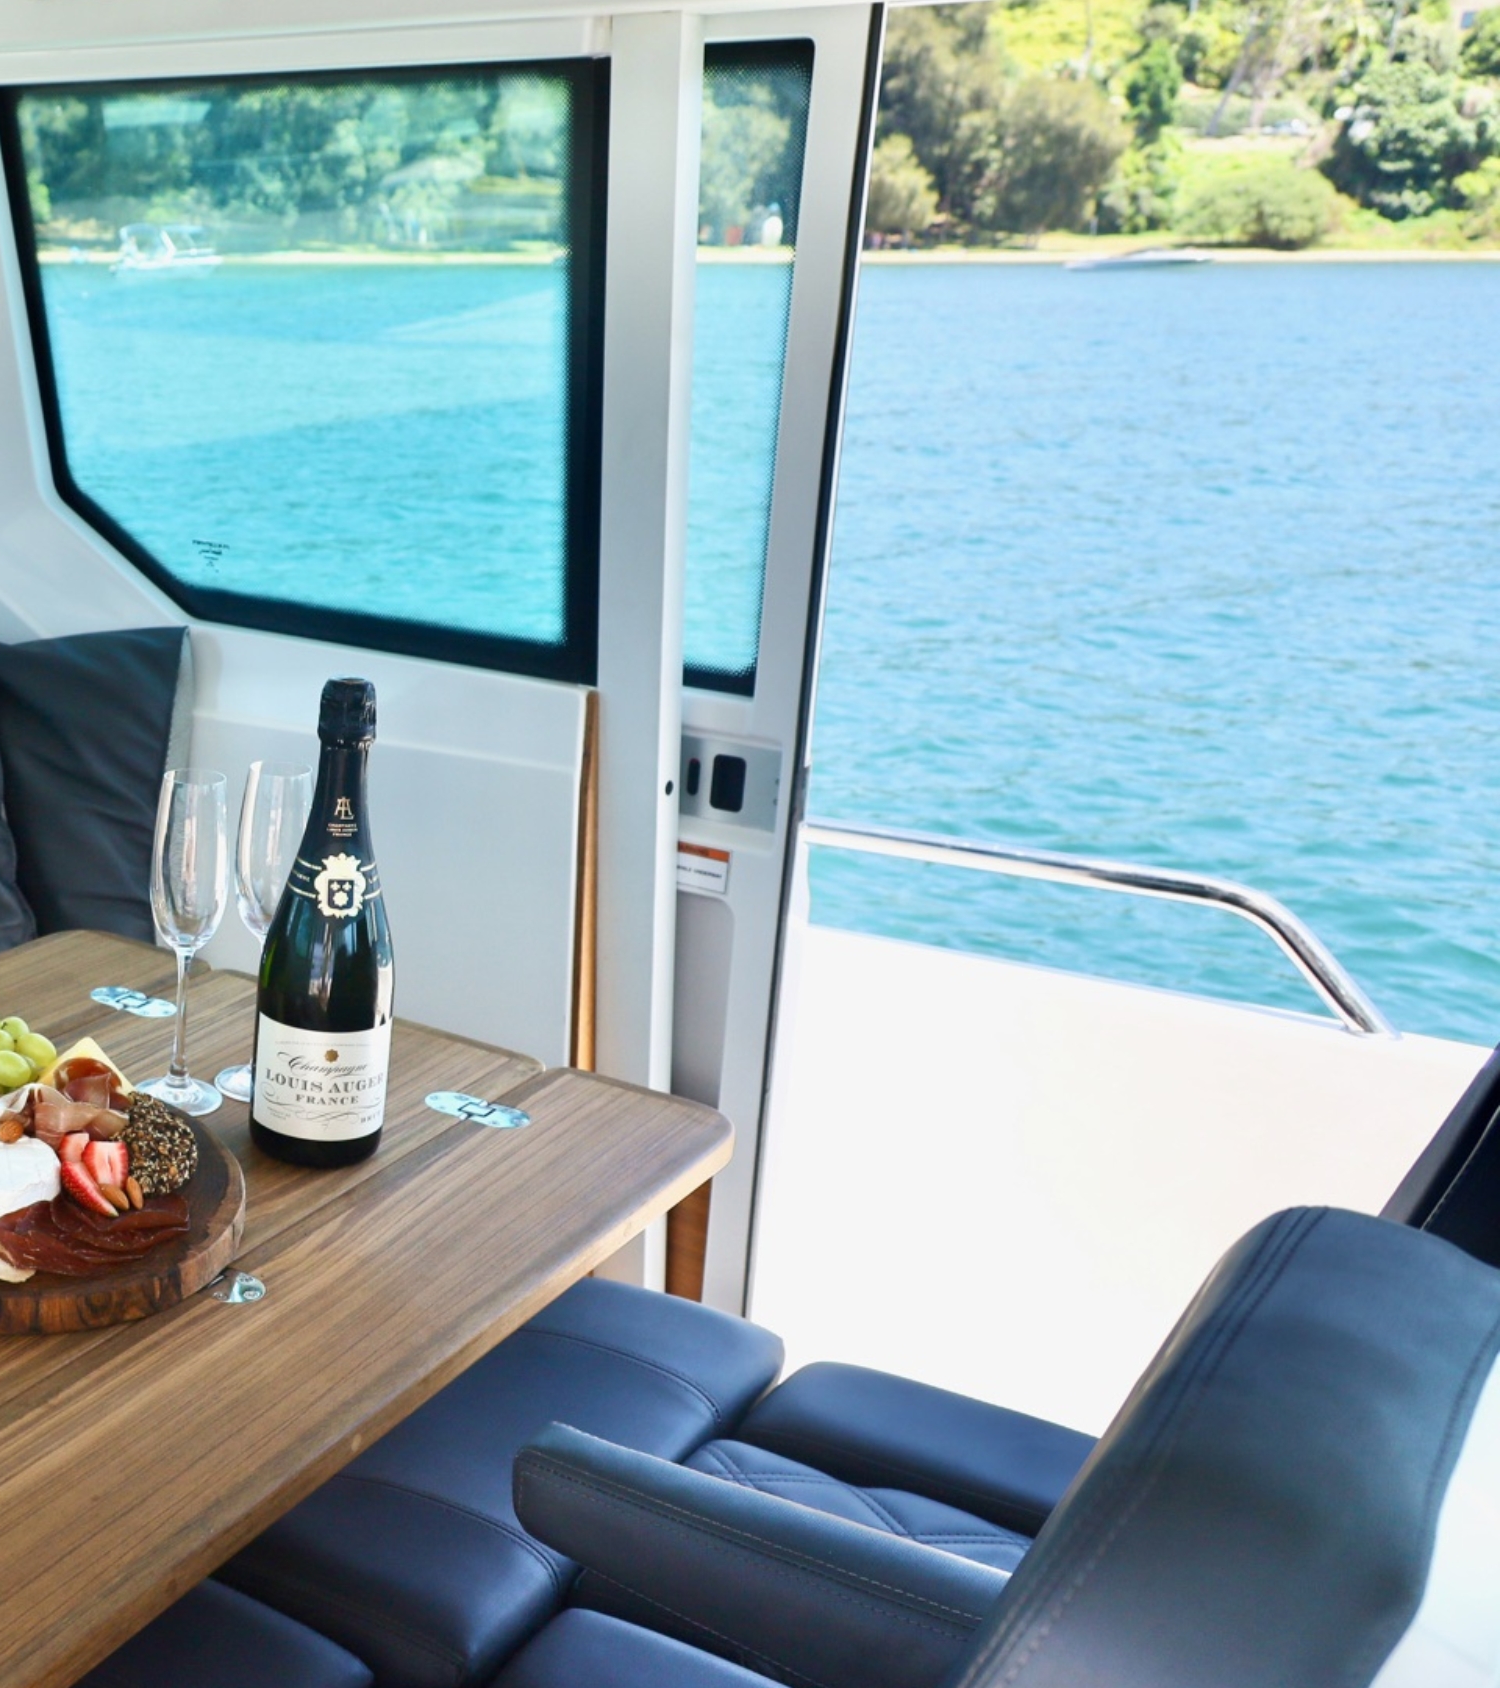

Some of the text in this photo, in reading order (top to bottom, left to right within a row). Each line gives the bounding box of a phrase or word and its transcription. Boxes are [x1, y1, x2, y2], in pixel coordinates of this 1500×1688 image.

[277, 1051, 368, 1078] Champagne
[265, 1068, 323, 1093] LOUIS
[295, 1093, 360, 1106] FRANCE
